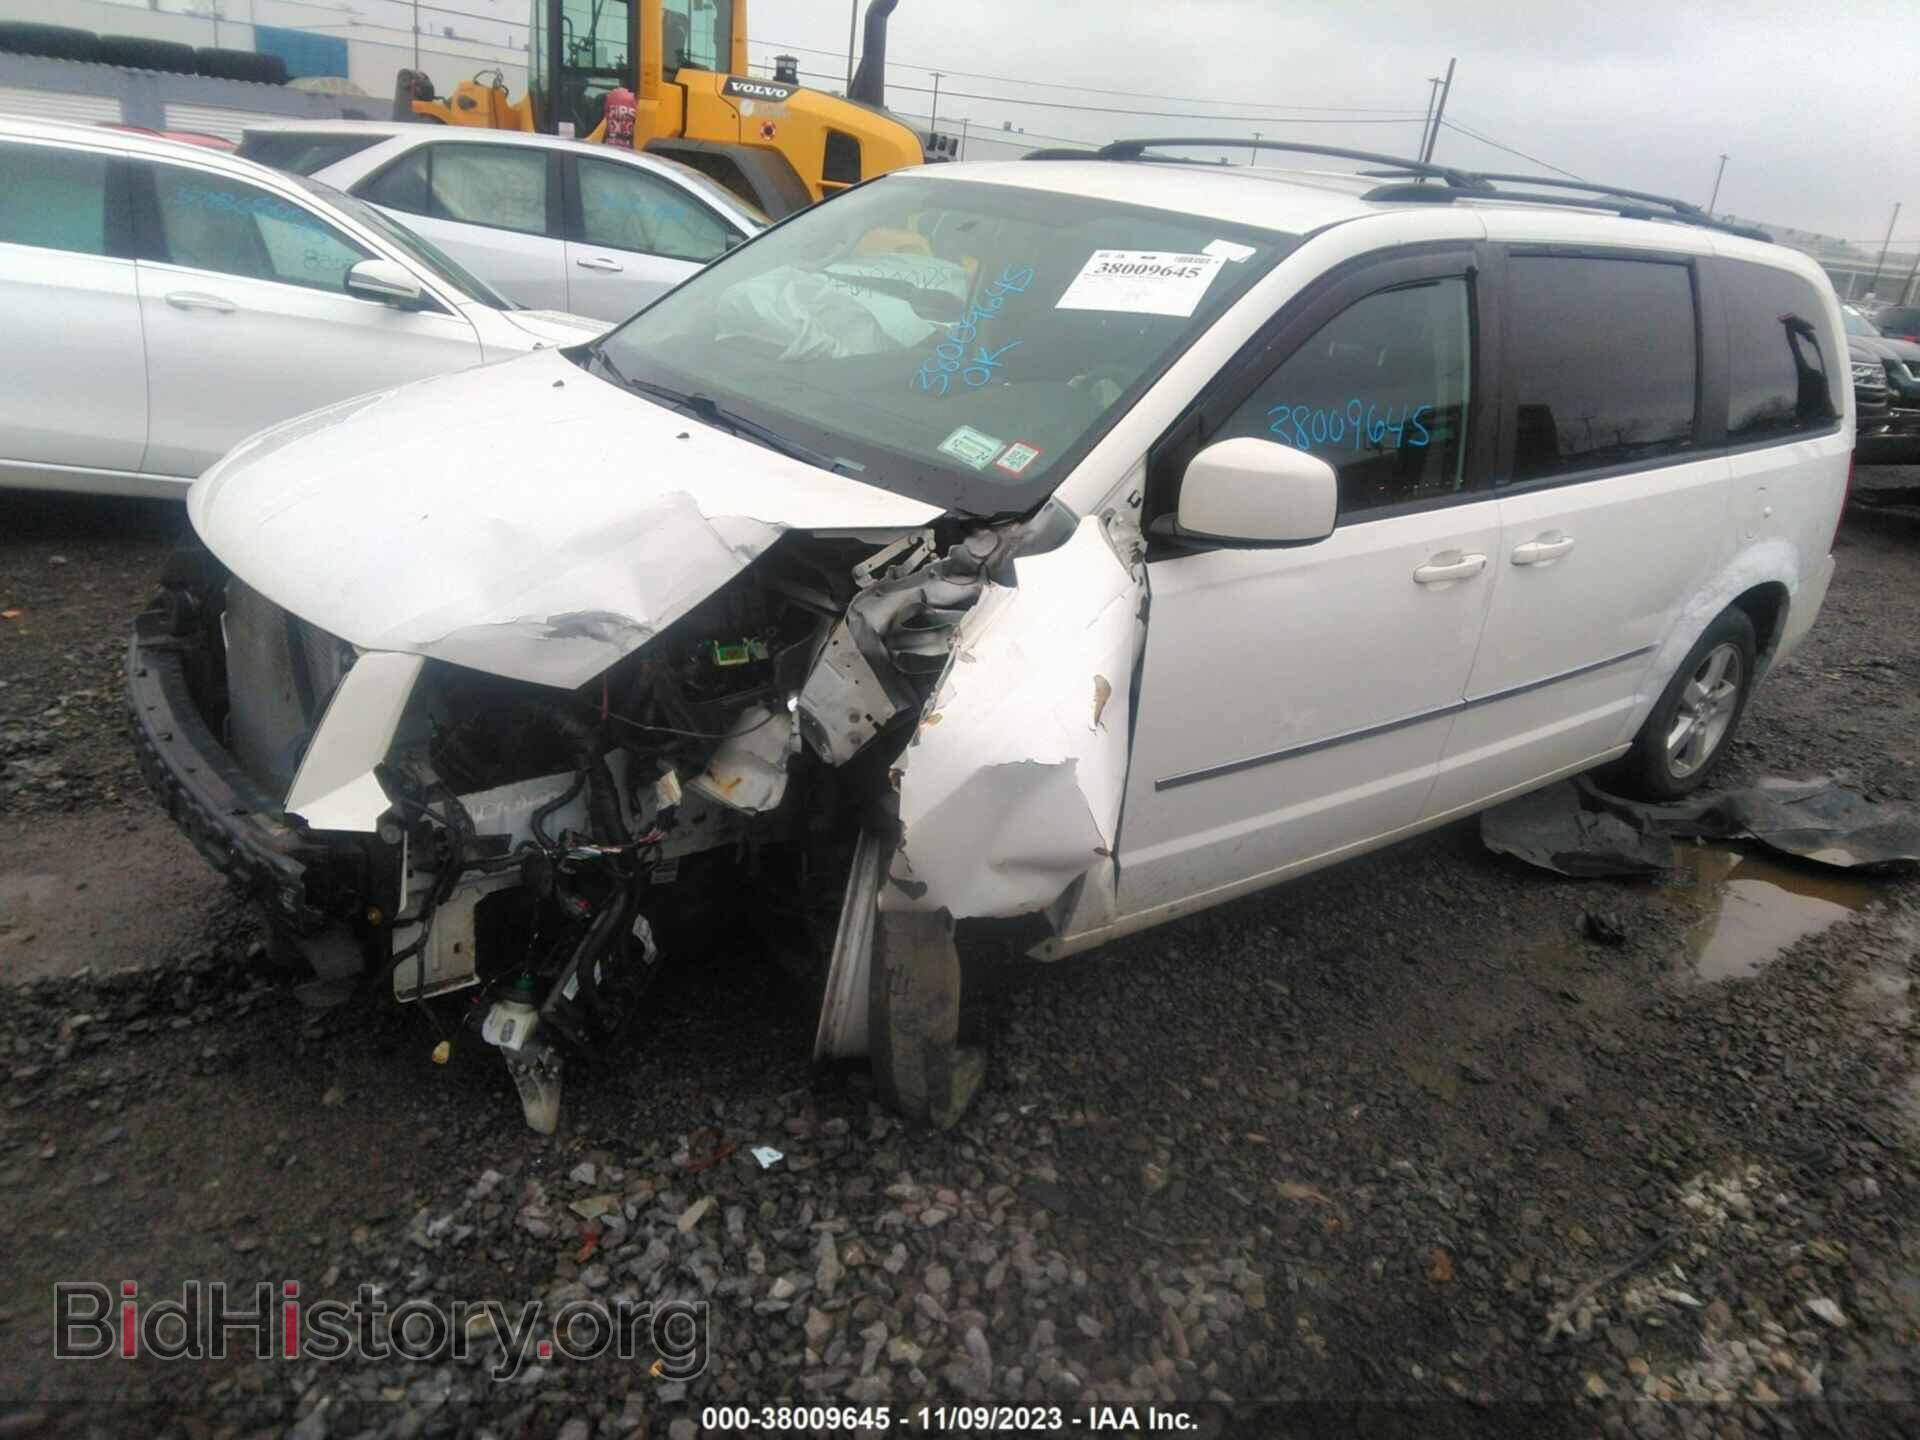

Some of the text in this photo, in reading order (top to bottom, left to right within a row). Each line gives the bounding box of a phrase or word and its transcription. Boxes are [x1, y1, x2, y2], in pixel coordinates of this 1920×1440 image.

[730, 81, 788, 98] VOLVO
[1094, 261, 1203, 280] 38009645
[1267, 399, 1433, 451] 38009645
